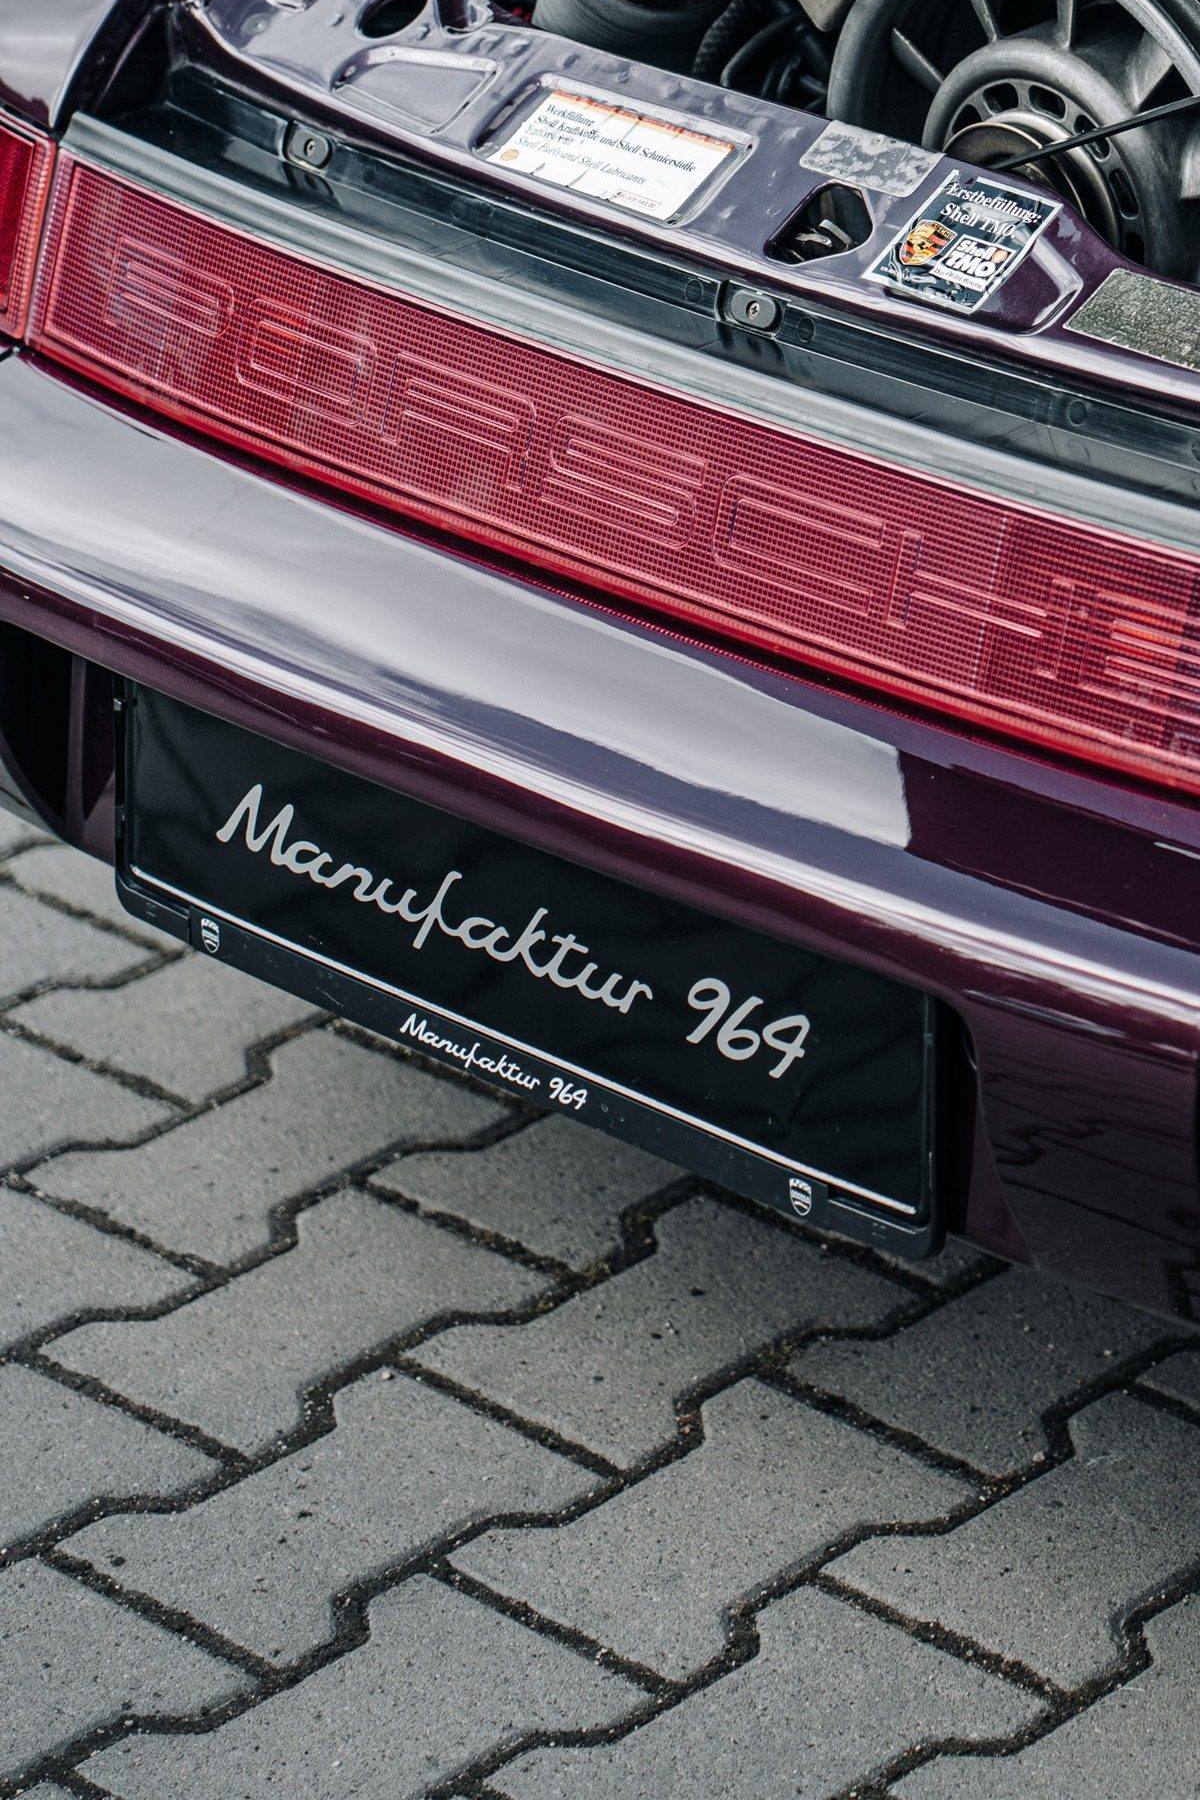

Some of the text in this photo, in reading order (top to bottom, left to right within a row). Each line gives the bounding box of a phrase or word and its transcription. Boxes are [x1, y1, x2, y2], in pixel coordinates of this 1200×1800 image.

[546, 103, 595, 128] Werkfüllung
[600, 136, 619, 148] und
[617, 140, 642, 155] Shell
[639, 147, 696, 173] Schmierstoffe
[600, 162, 647, 185] Lubricants
[940, 202, 981, 228] Shell
[945, 182, 1043, 225] Erstbefüllung:
[945, 250, 997, 279] TMO
[956, 239, 997, 261] Shell
[216, 783, 812, 1080] Manufaktur 964
[399, 1012, 589, 1111] Manufaktur 964
